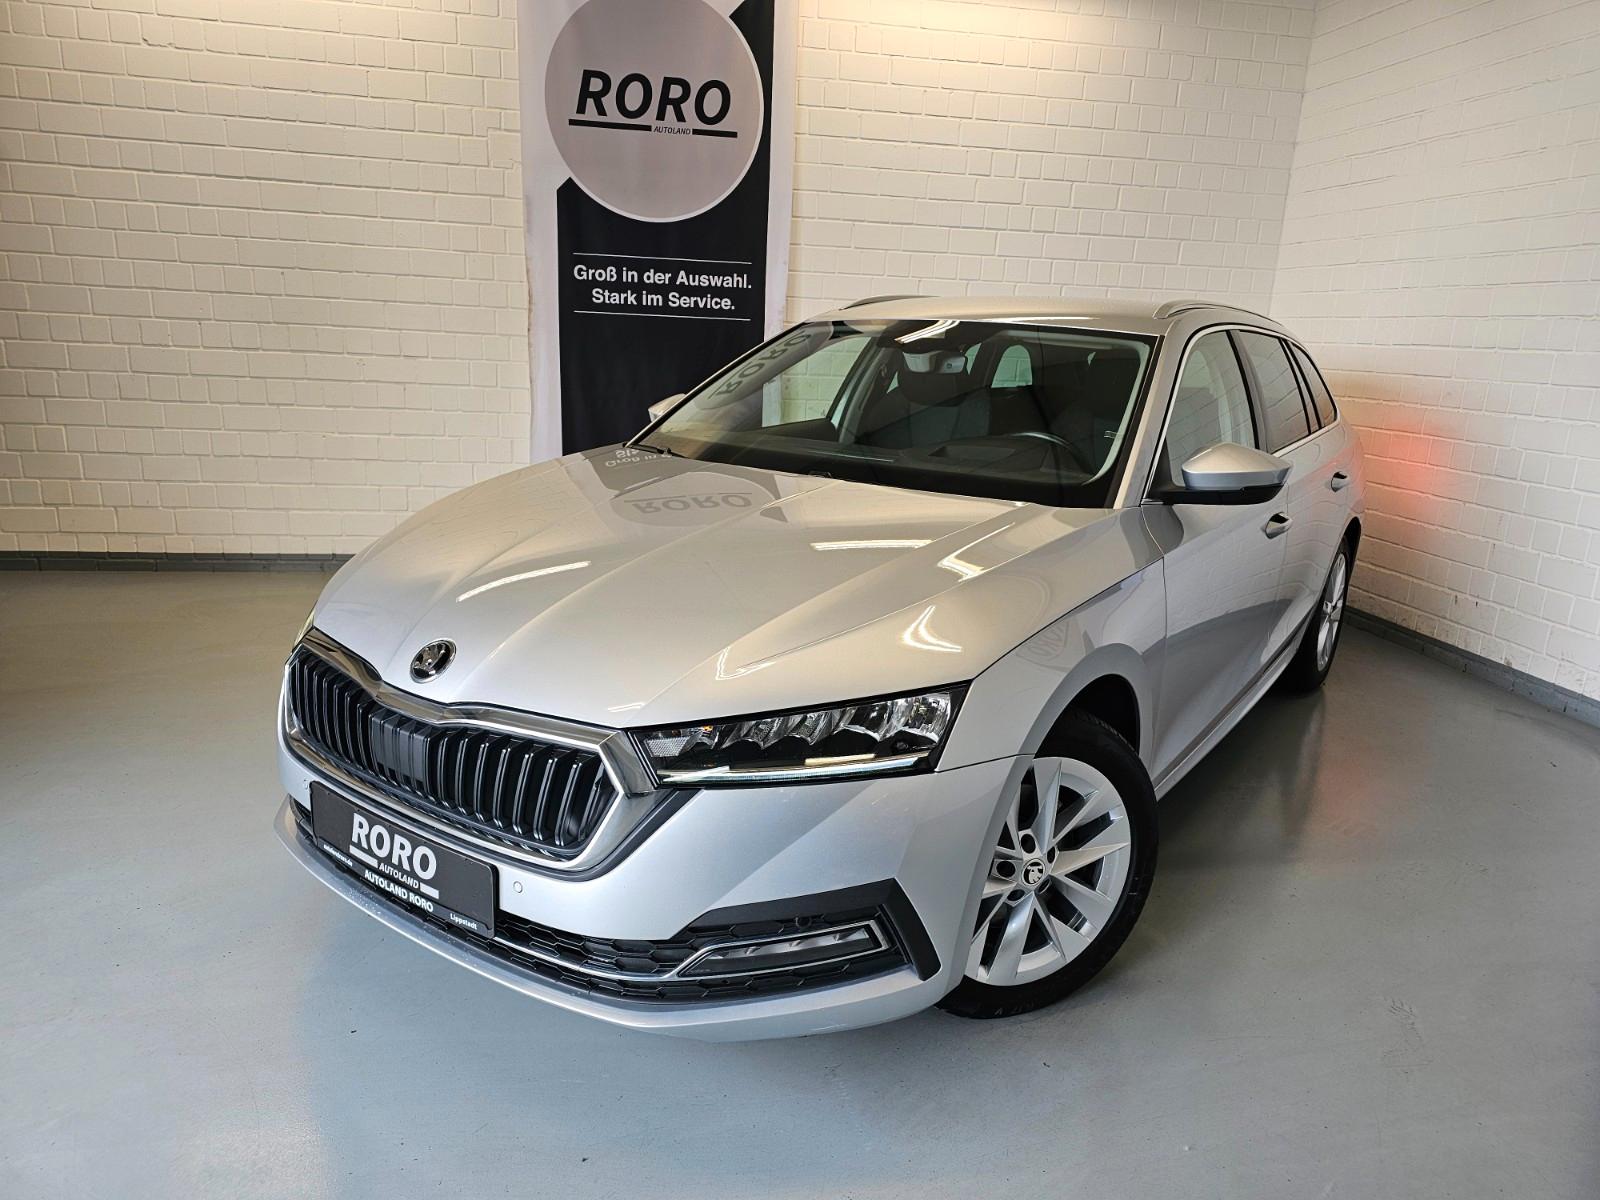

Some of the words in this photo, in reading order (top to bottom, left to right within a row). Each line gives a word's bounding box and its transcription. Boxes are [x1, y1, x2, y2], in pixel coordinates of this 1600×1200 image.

[576, 69, 731, 126] RORO
[653, 126, 691, 135] AUTOLAND
[573, 265, 617, 282] Groß
[622, 267, 638, 283] in
[643, 268, 671, 285] der
[676, 270, 752, 289] Auswahl.
[592, 288, 637, 305] Stark
[642, 291, 663, 307] im
[668, 291, 735, 310] Service.
[352, 813, 437, 880] RORO
[378, 862, 420, 889] AUTOLAND
[364, 869, 408, 899] AUTOLAND
[409, 892, 434, 912] RORO
[450, 912, 478, 930] Lippstadt
